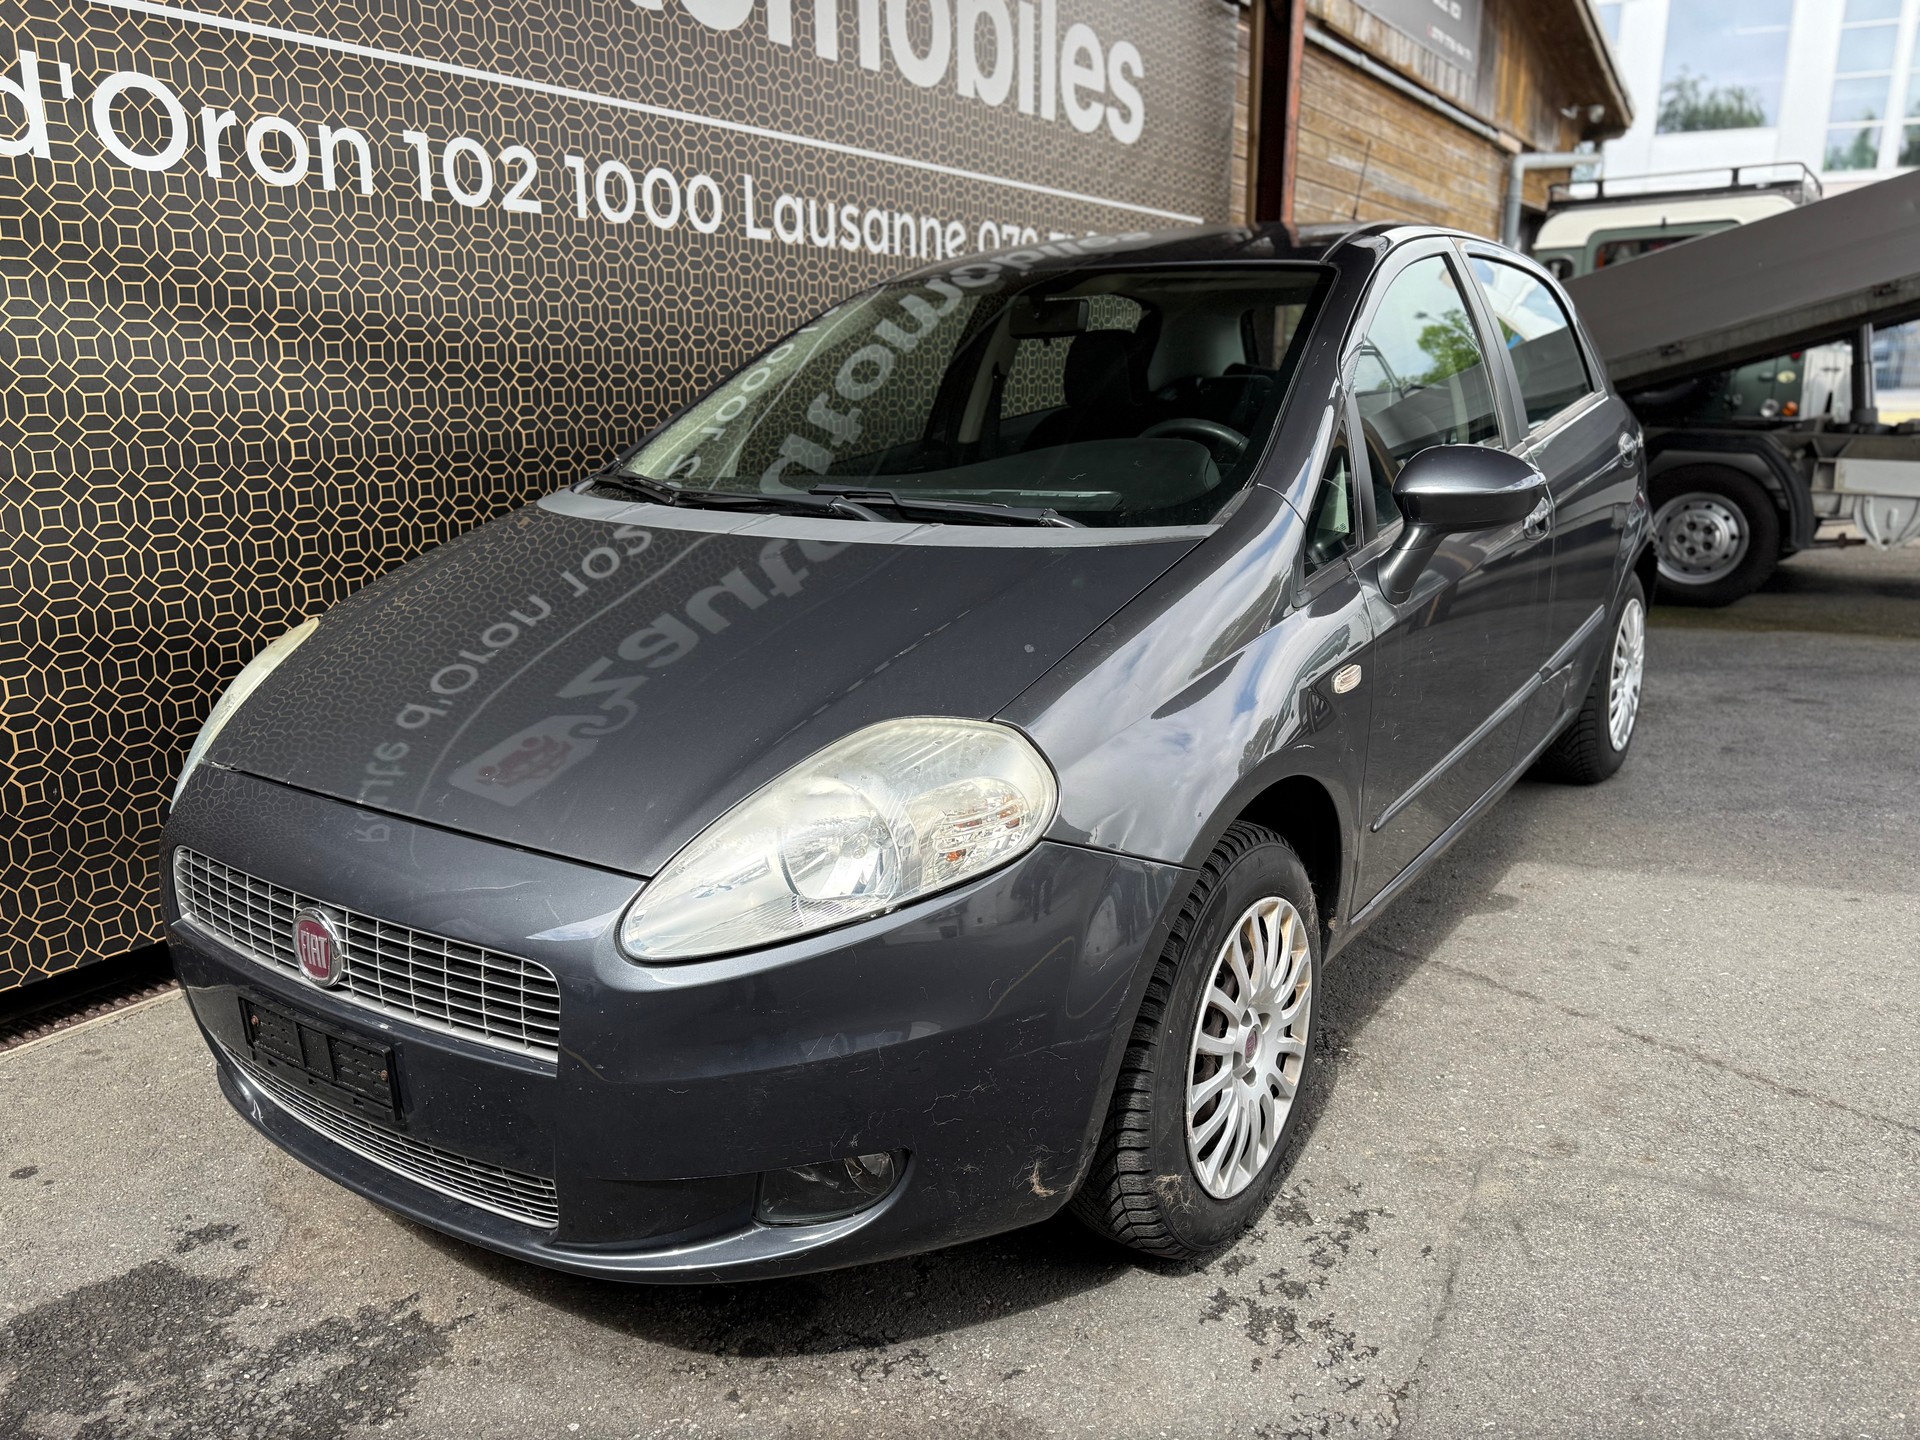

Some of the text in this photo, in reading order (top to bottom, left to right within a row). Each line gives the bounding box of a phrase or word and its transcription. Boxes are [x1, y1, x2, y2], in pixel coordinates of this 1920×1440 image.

[630, 0, 1144, 144] obiles
[0, 50, 373, 195] d'Oron
[402, 129, 542, 214] 102
[564, 154, 722, 234] 1000
[744, 174, 967, 261] Lausanne
[300, 929, 328, 969] FIAT
